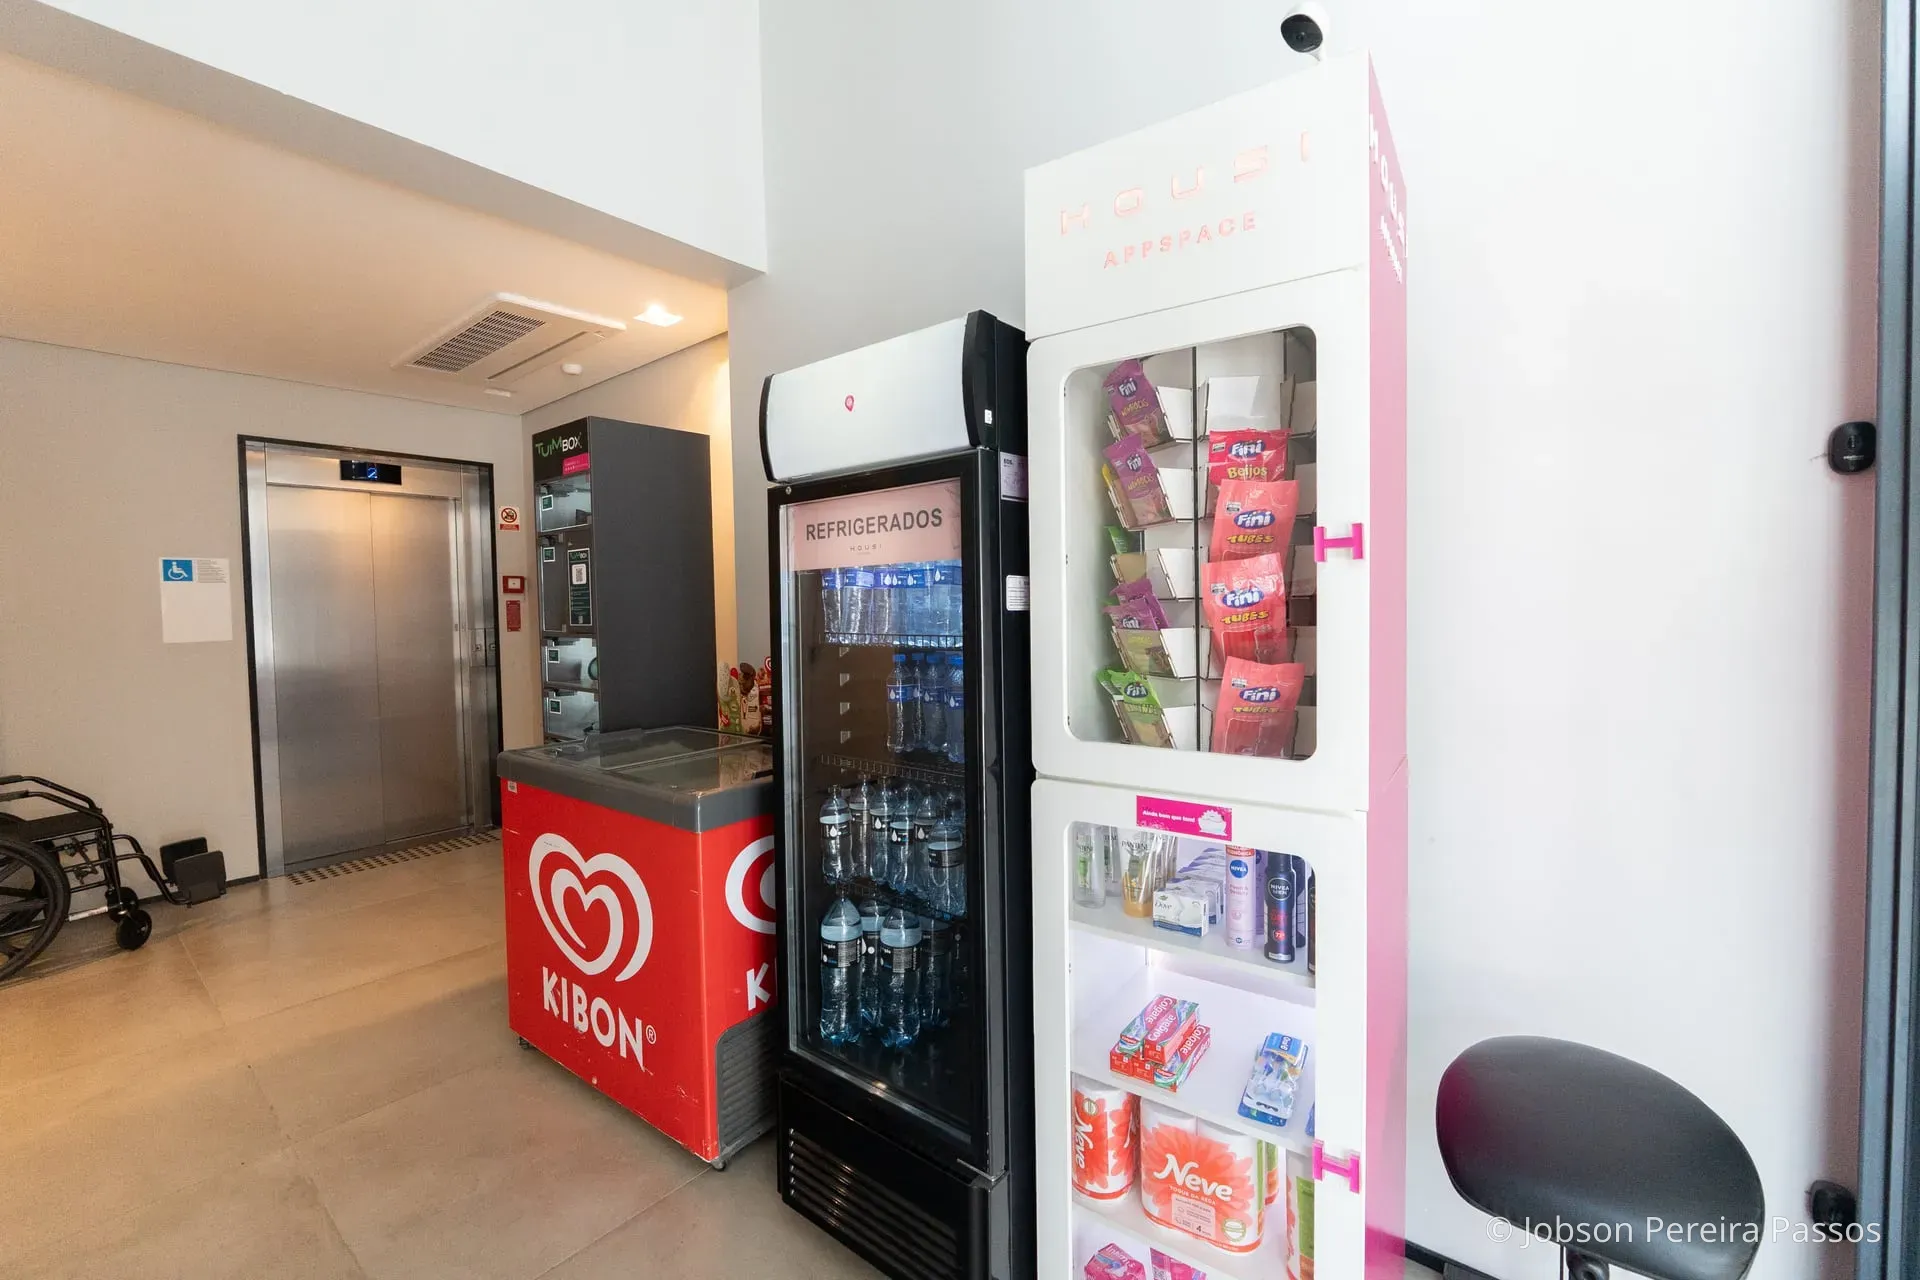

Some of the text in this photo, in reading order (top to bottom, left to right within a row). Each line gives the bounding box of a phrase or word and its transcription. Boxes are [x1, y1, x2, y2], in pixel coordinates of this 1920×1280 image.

[1060, 131, 1309, 235] HOUSI
[1104, 211, 1256, 269] APPSPACE
[1231, 440, 1263, 457] Fini
[1227, 464, 1268, 479] Beijos
[806, 508, 942, 541] REFRIGERADOS
[1237, 511, 1271, 527] Fini
[1226, 534, 1274, 544] TUBES
[1225, 587, 1261, 607] Fini
[1221, 610, 1269, 624] TUBES
[1242, 688, 1277, 701] Fini
[1230, 865, 1247, 873] NIVEA
[1145, 997, 1174, 1024] Colgate
[1147, 1014, 1177, 1041] Colgate
[1180, 1026, 1206, 1055] Colgate
[1153, 1153, 1233, 1202] Neve
